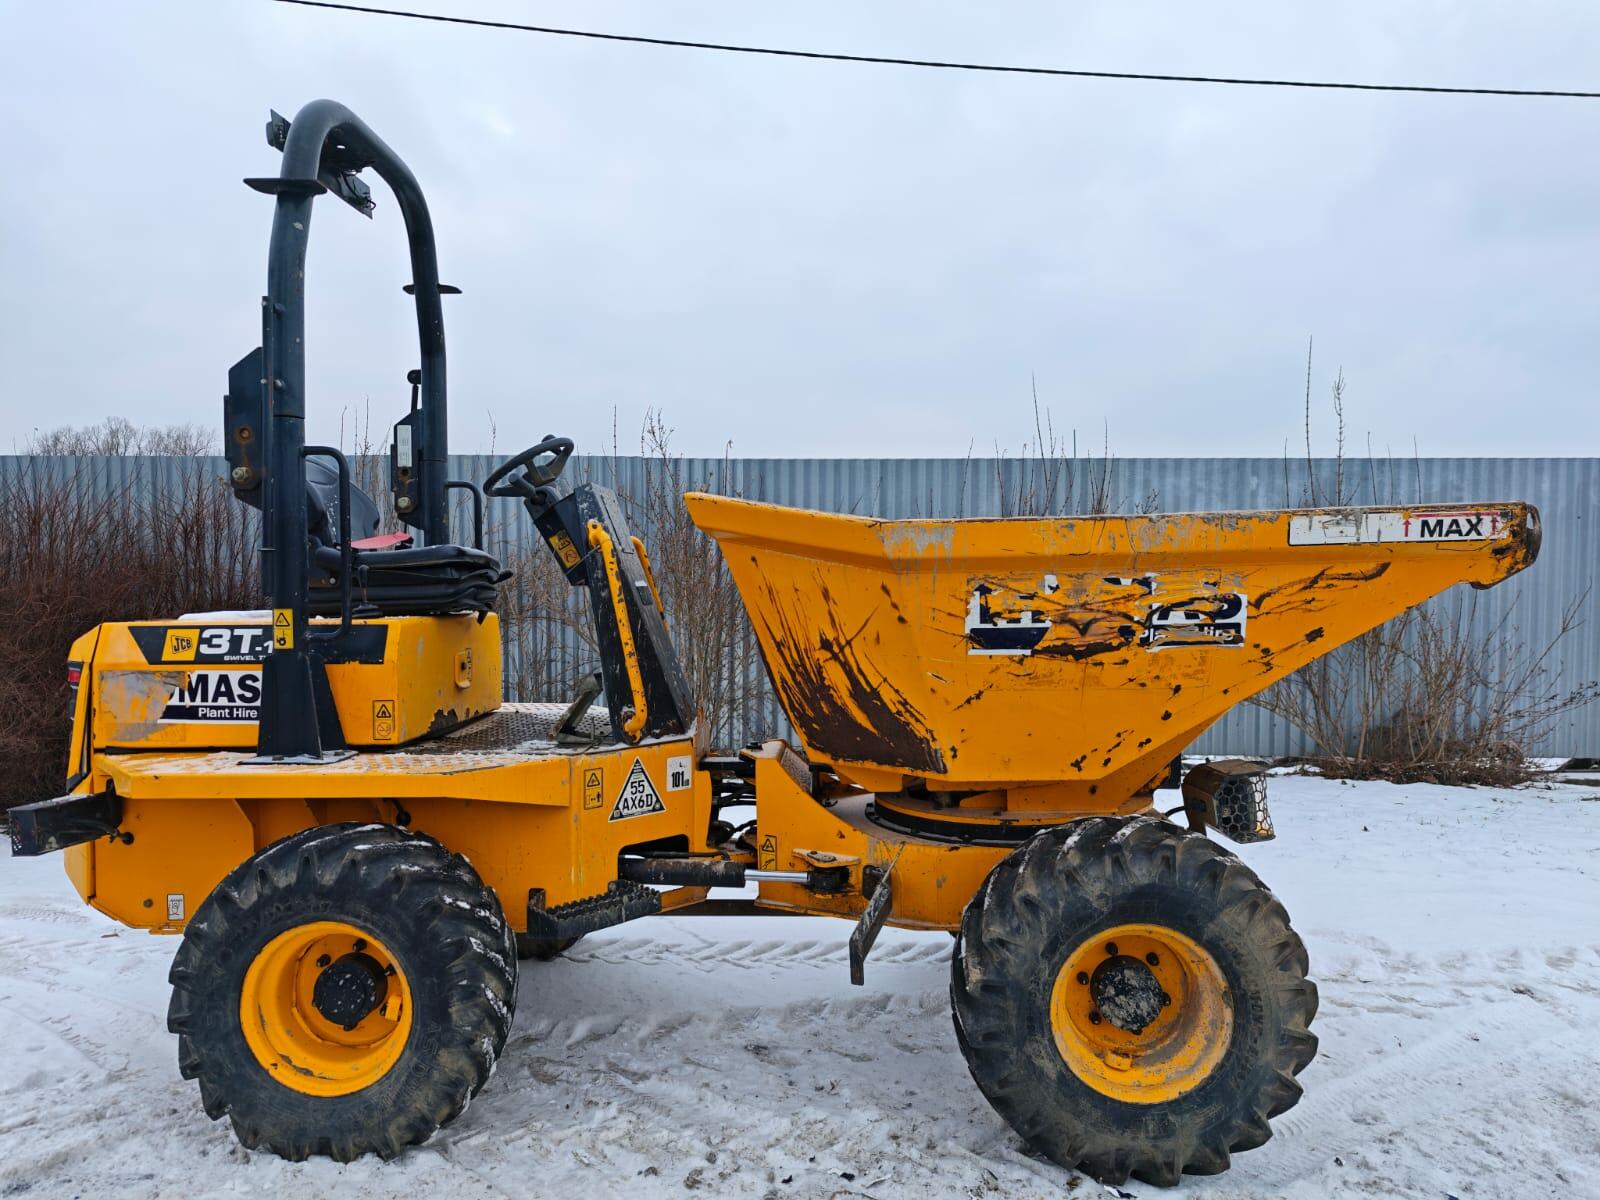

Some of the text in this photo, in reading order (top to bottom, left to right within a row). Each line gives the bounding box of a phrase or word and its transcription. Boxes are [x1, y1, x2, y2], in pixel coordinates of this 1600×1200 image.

[1420, 518, 1482, 538] MAX
[173, 636, 192, 653] JCB
[170, 673, 261, 704] MAS
[198, 707, 258, 718] Plant Hire
[630, 780, 645, 795] 55
[622, 794, 653, 811] AX6D
